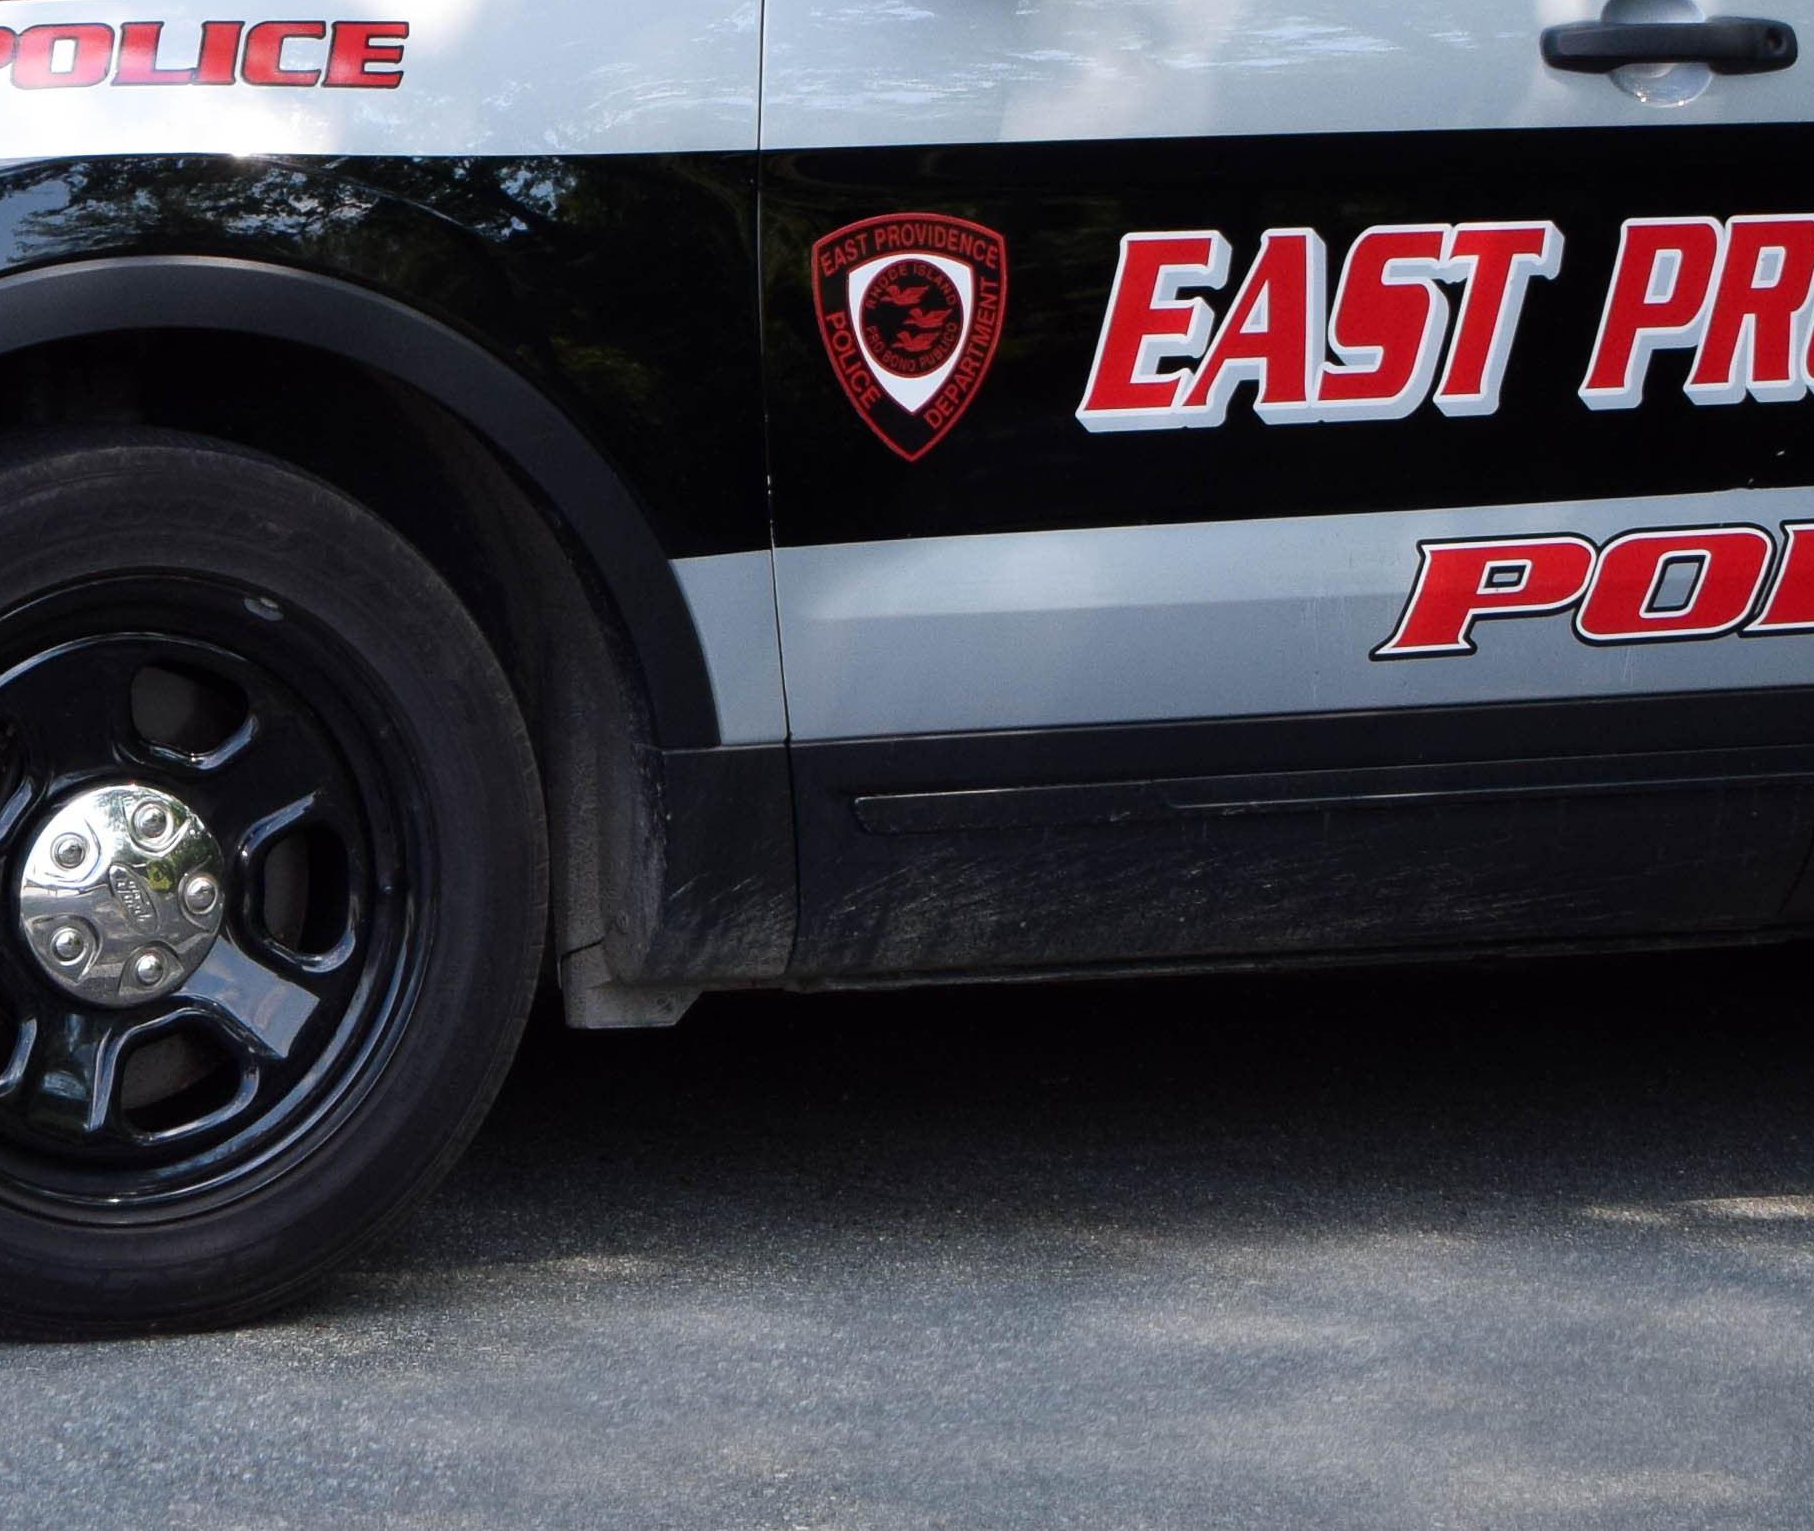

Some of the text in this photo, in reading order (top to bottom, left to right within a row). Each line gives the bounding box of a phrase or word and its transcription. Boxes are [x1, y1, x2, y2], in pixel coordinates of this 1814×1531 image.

[819, 224, 998, 277] EAST PROVIDENCE
[864, 264, 957, 310] RHODE ISLAND
[826, 310, 882, 410] POLICE
[882, 350, 917, 373] BONO
[919, 322, 958, 372] PUBLICO
[923, 276, 1000, 431] DEPARTMENT
[1075, 220, 1566, 433] EAST
